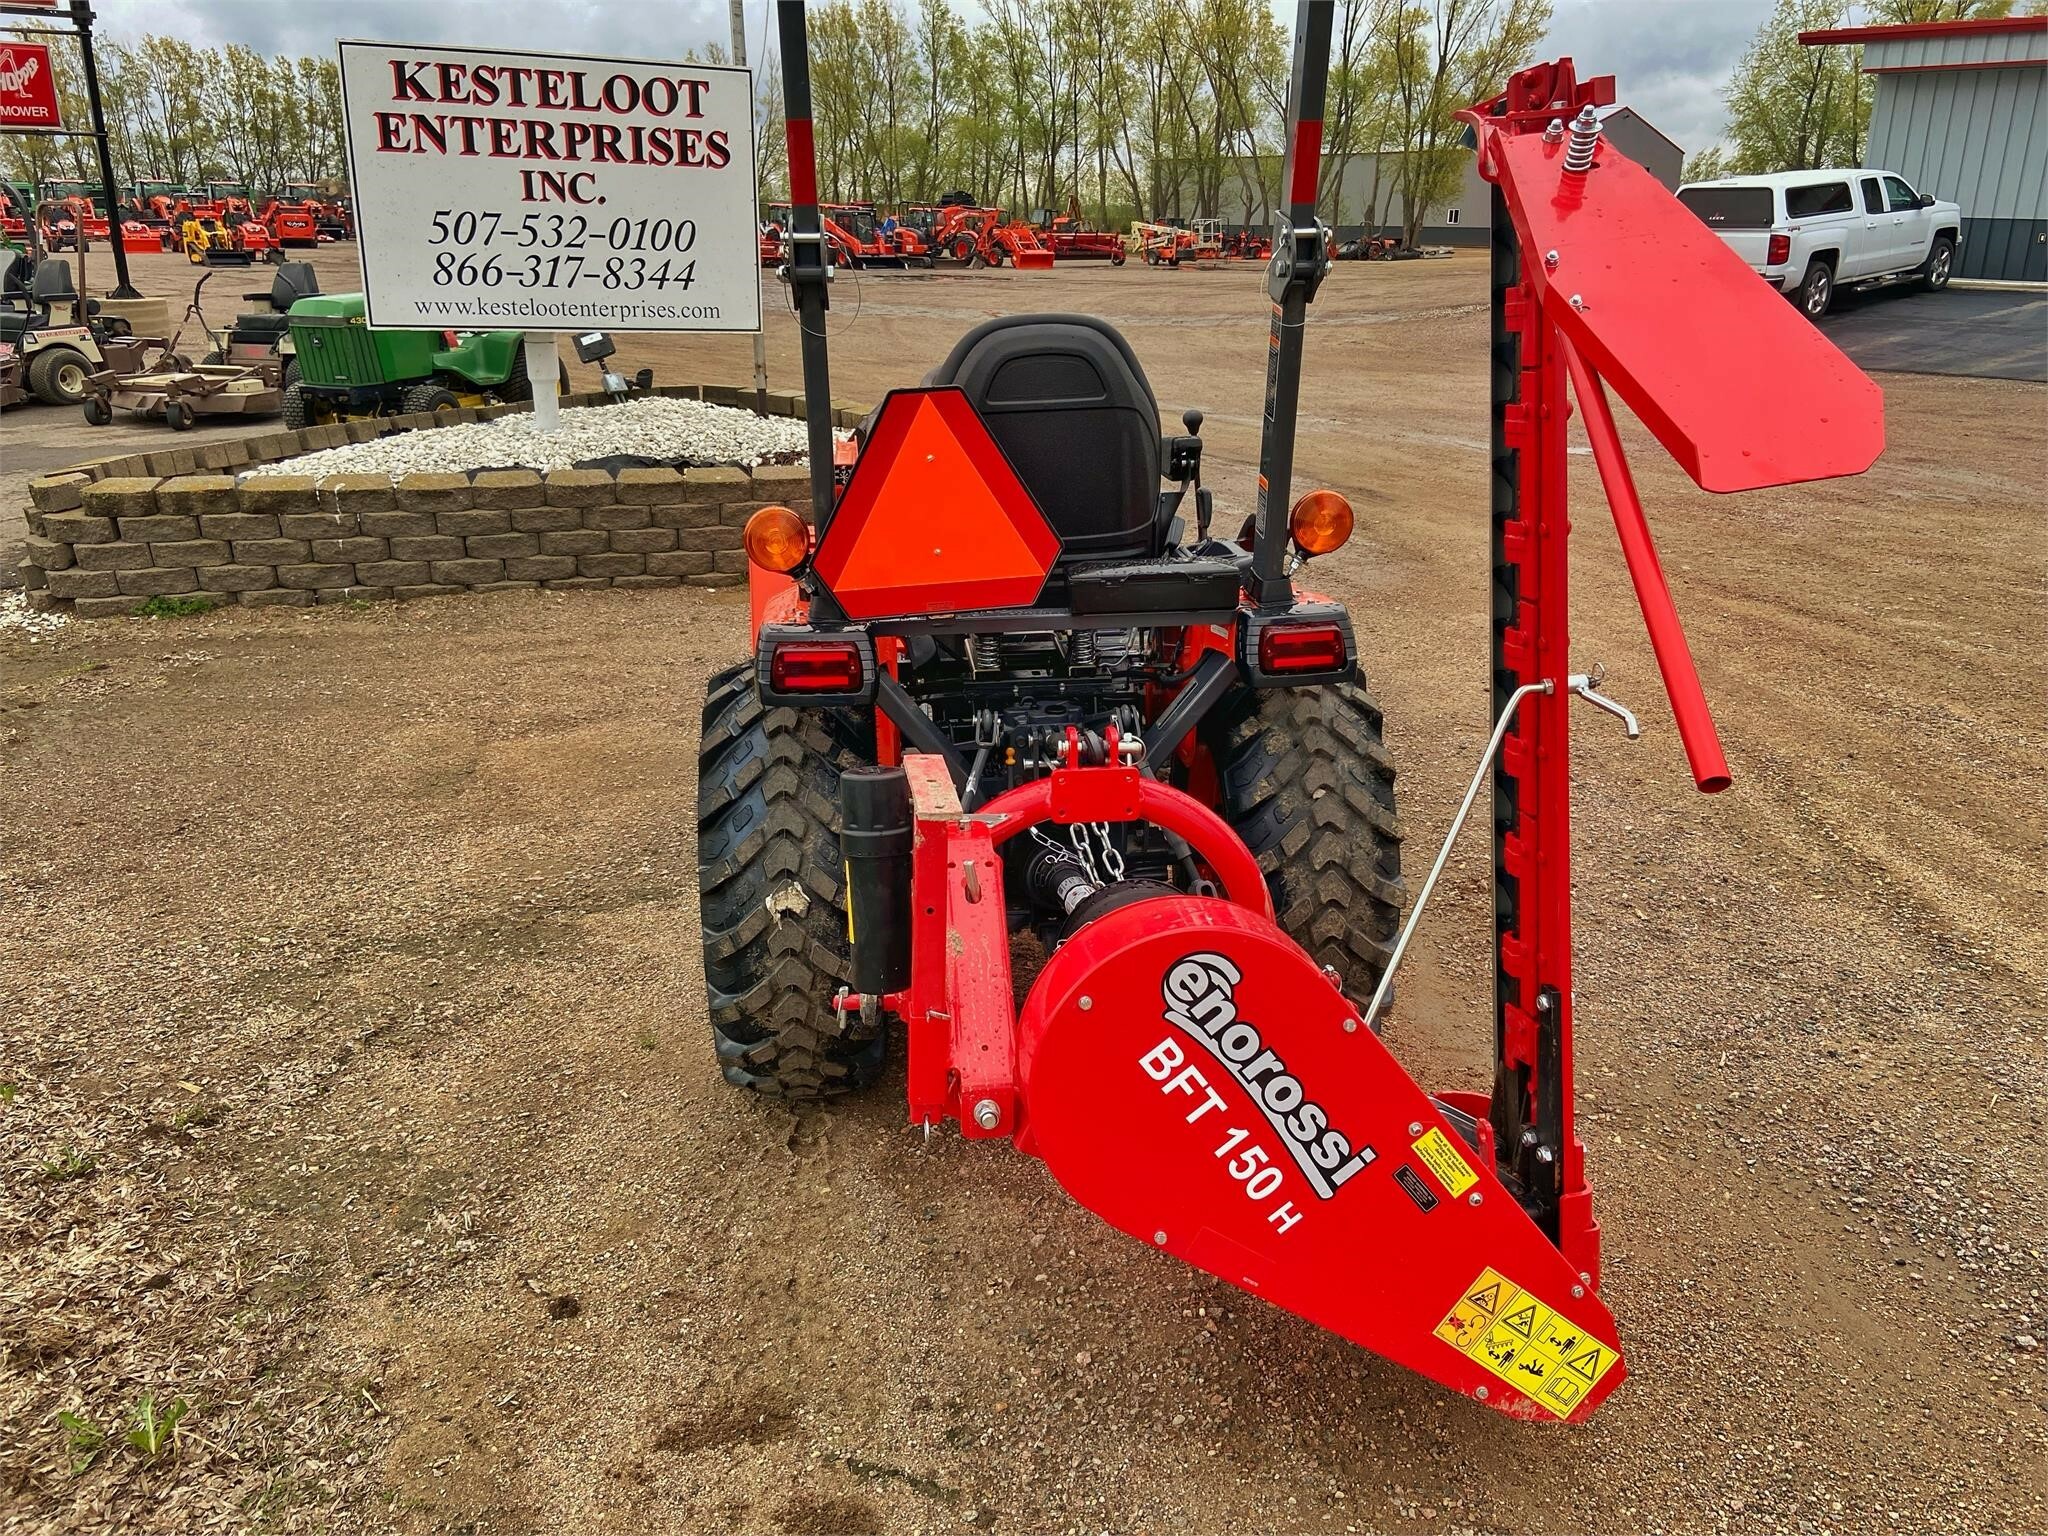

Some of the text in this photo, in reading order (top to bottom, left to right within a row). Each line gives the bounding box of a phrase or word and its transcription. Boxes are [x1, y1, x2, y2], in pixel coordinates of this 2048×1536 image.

[388, 59, 710, 118] KESTELOOT
[0, 105, 49, 117] MOWER
[373, 112, 731, 169] ENTERPRISES
[519, 169, 607, 205] INC.
[428, 210, 697, 252] 507-532-0100
[432, 251, 697, 291] 866-317-8344
[414, 297, 721, 322] www.kestelootenterprises.com
[1162, 951, 1378, 1200] enorossi
[1138, 1036, 1303, 1235] BFT 150 H
